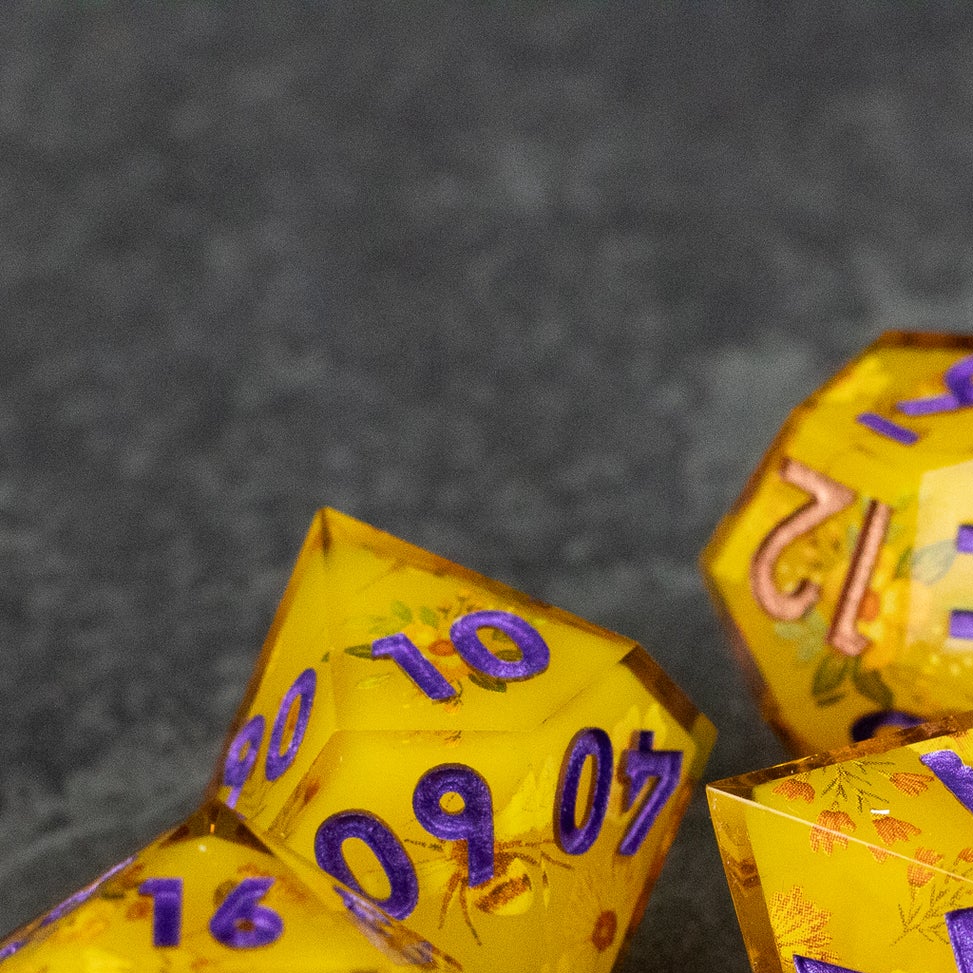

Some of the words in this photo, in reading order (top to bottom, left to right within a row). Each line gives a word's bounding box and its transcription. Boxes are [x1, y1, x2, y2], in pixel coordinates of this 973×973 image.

[750, 457, 891, 657] 12
[371, 608, 551, 701] 10
[555, 727, 685, 857] 40
[139, 877, 284, 948] 16
